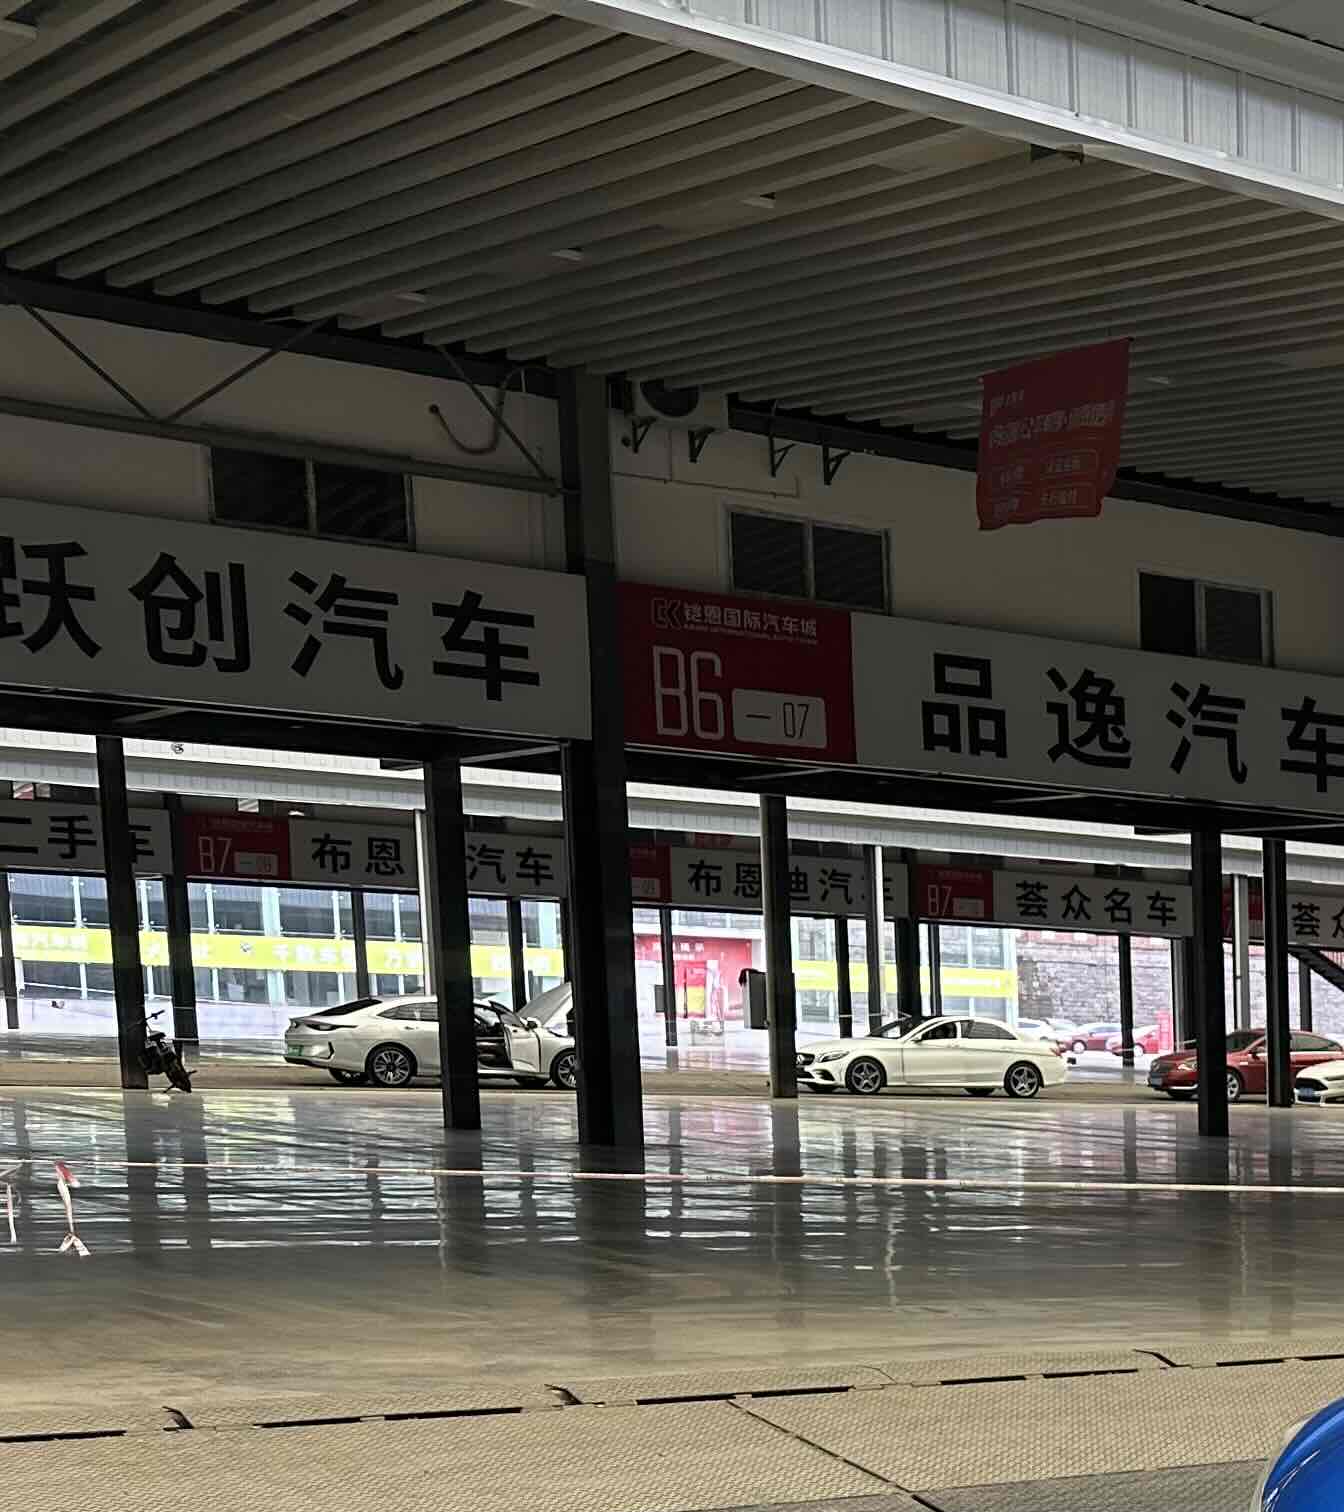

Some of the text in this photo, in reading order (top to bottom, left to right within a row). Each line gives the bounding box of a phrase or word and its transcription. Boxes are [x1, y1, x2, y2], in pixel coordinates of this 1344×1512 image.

[0, 536, 541, 702] 跃创汽车
[652, 645, 725, 740] B6
[199, 836, 232, 873] B7
[311, 833, 555, 886] 布恩汽车
[1015, 880, 1177, 926] 荟众名车
